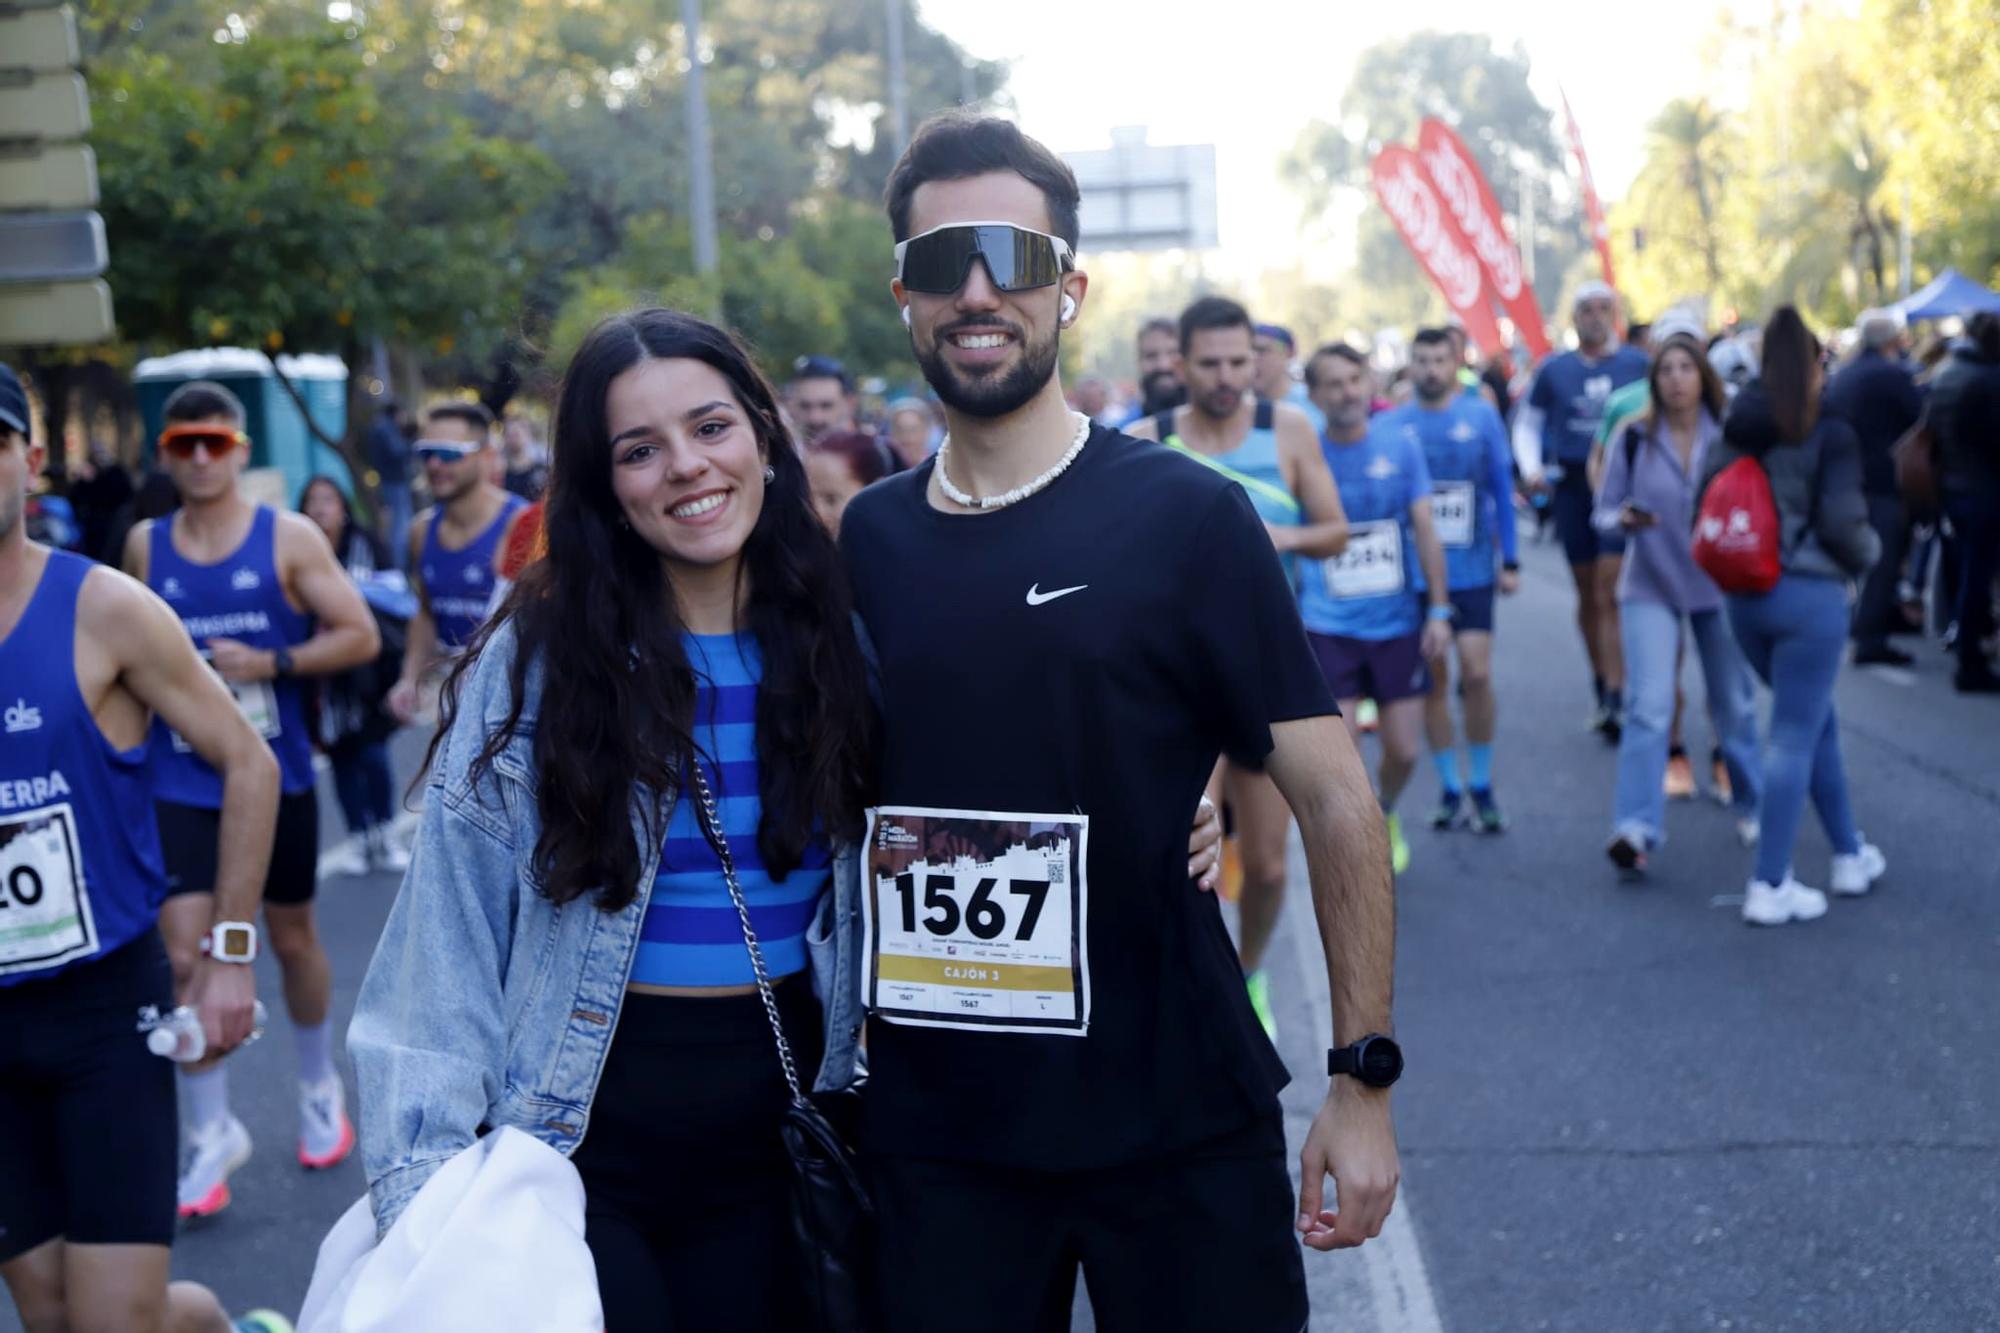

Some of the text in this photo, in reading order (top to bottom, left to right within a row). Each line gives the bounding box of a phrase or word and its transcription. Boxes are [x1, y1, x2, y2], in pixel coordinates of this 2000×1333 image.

[896, 873, 1051, 941] 1567
[944, 965, 999, 981] CAJÓN 3
[961, 1000, 979, 1009] 1567
